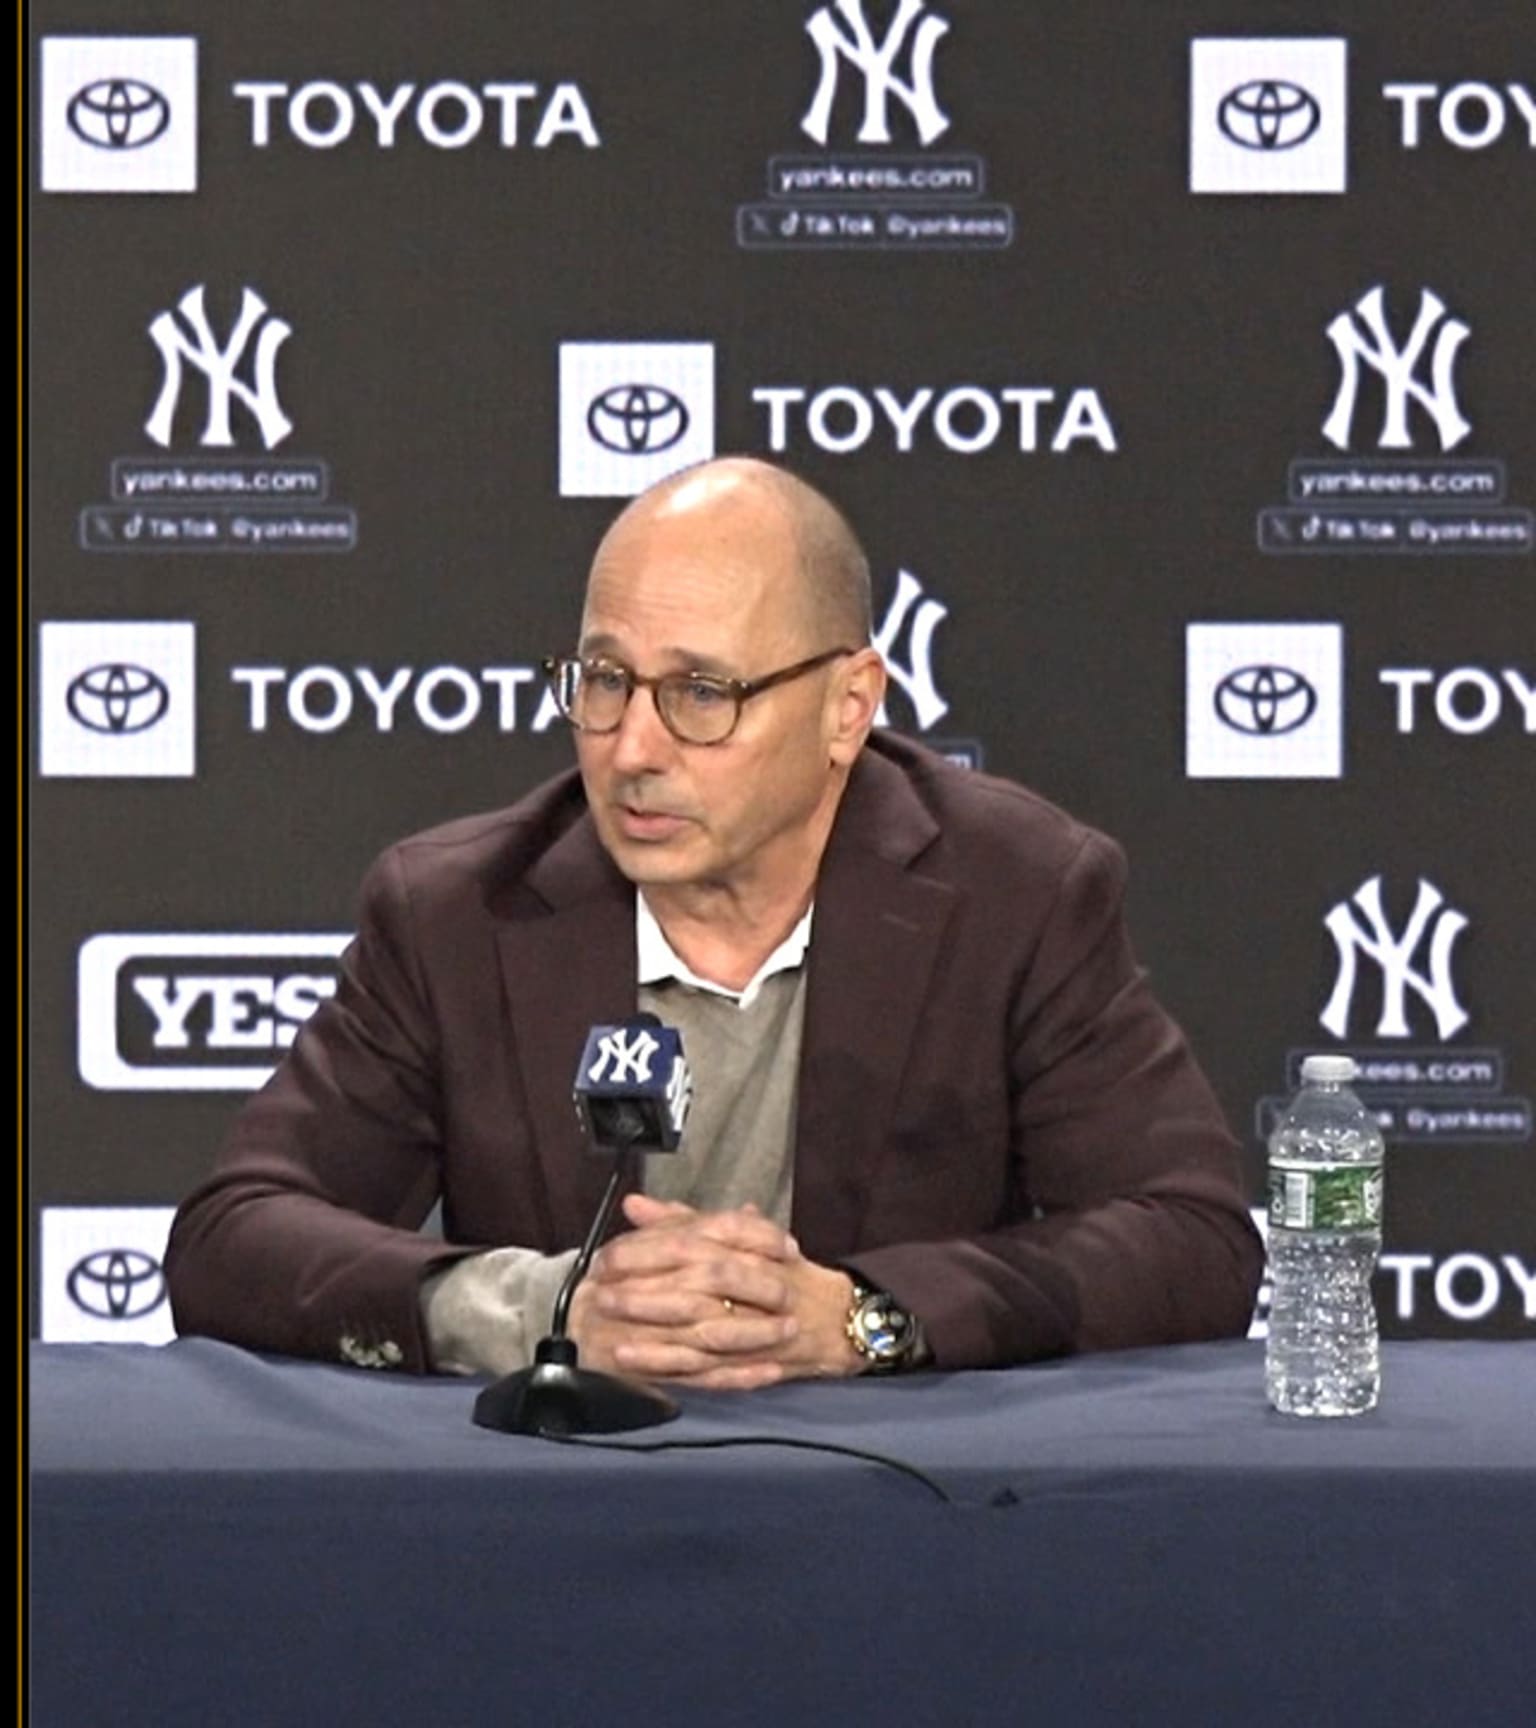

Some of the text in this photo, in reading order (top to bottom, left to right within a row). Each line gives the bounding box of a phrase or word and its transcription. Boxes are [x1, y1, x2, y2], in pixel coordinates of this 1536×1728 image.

[233, 81, 600, 148] TOYOTA
[781, 166, 973, 192] yankees.com
[753, 386, 1117, 453] TOYOTA
[123, 469, 317, 496] yankees.com
[1301, 471, 1494, 497] yankees.com
[133, 975, 337, 1047] YES
